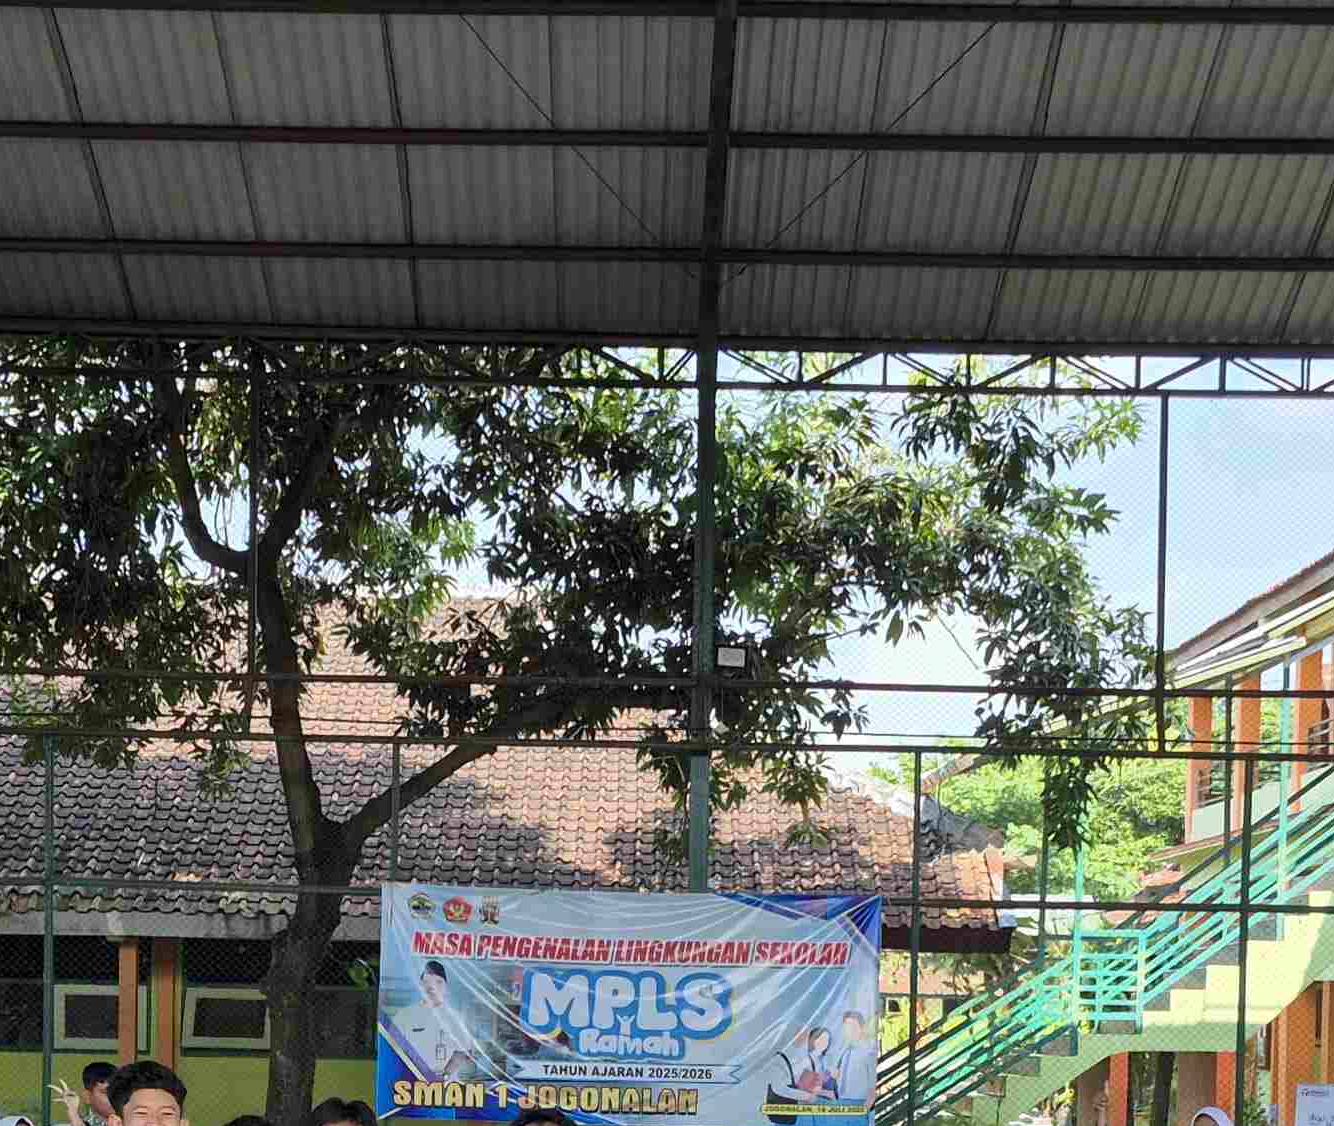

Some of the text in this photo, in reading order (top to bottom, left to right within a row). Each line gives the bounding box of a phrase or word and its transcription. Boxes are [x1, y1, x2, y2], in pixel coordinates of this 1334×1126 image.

[414, 931, 849, 966] MASA PENGENALAN LINGKUNGAN SEKOLAH
[525, 970, 727, 1034] MPLS
[578, 1028, 680, 1057] Ramah
[542, 1064, 713, 1080] TAHUN AJARAN 2025/2026
[393, 1080, 700, 1115] SMAN 1 JOGONALAN
